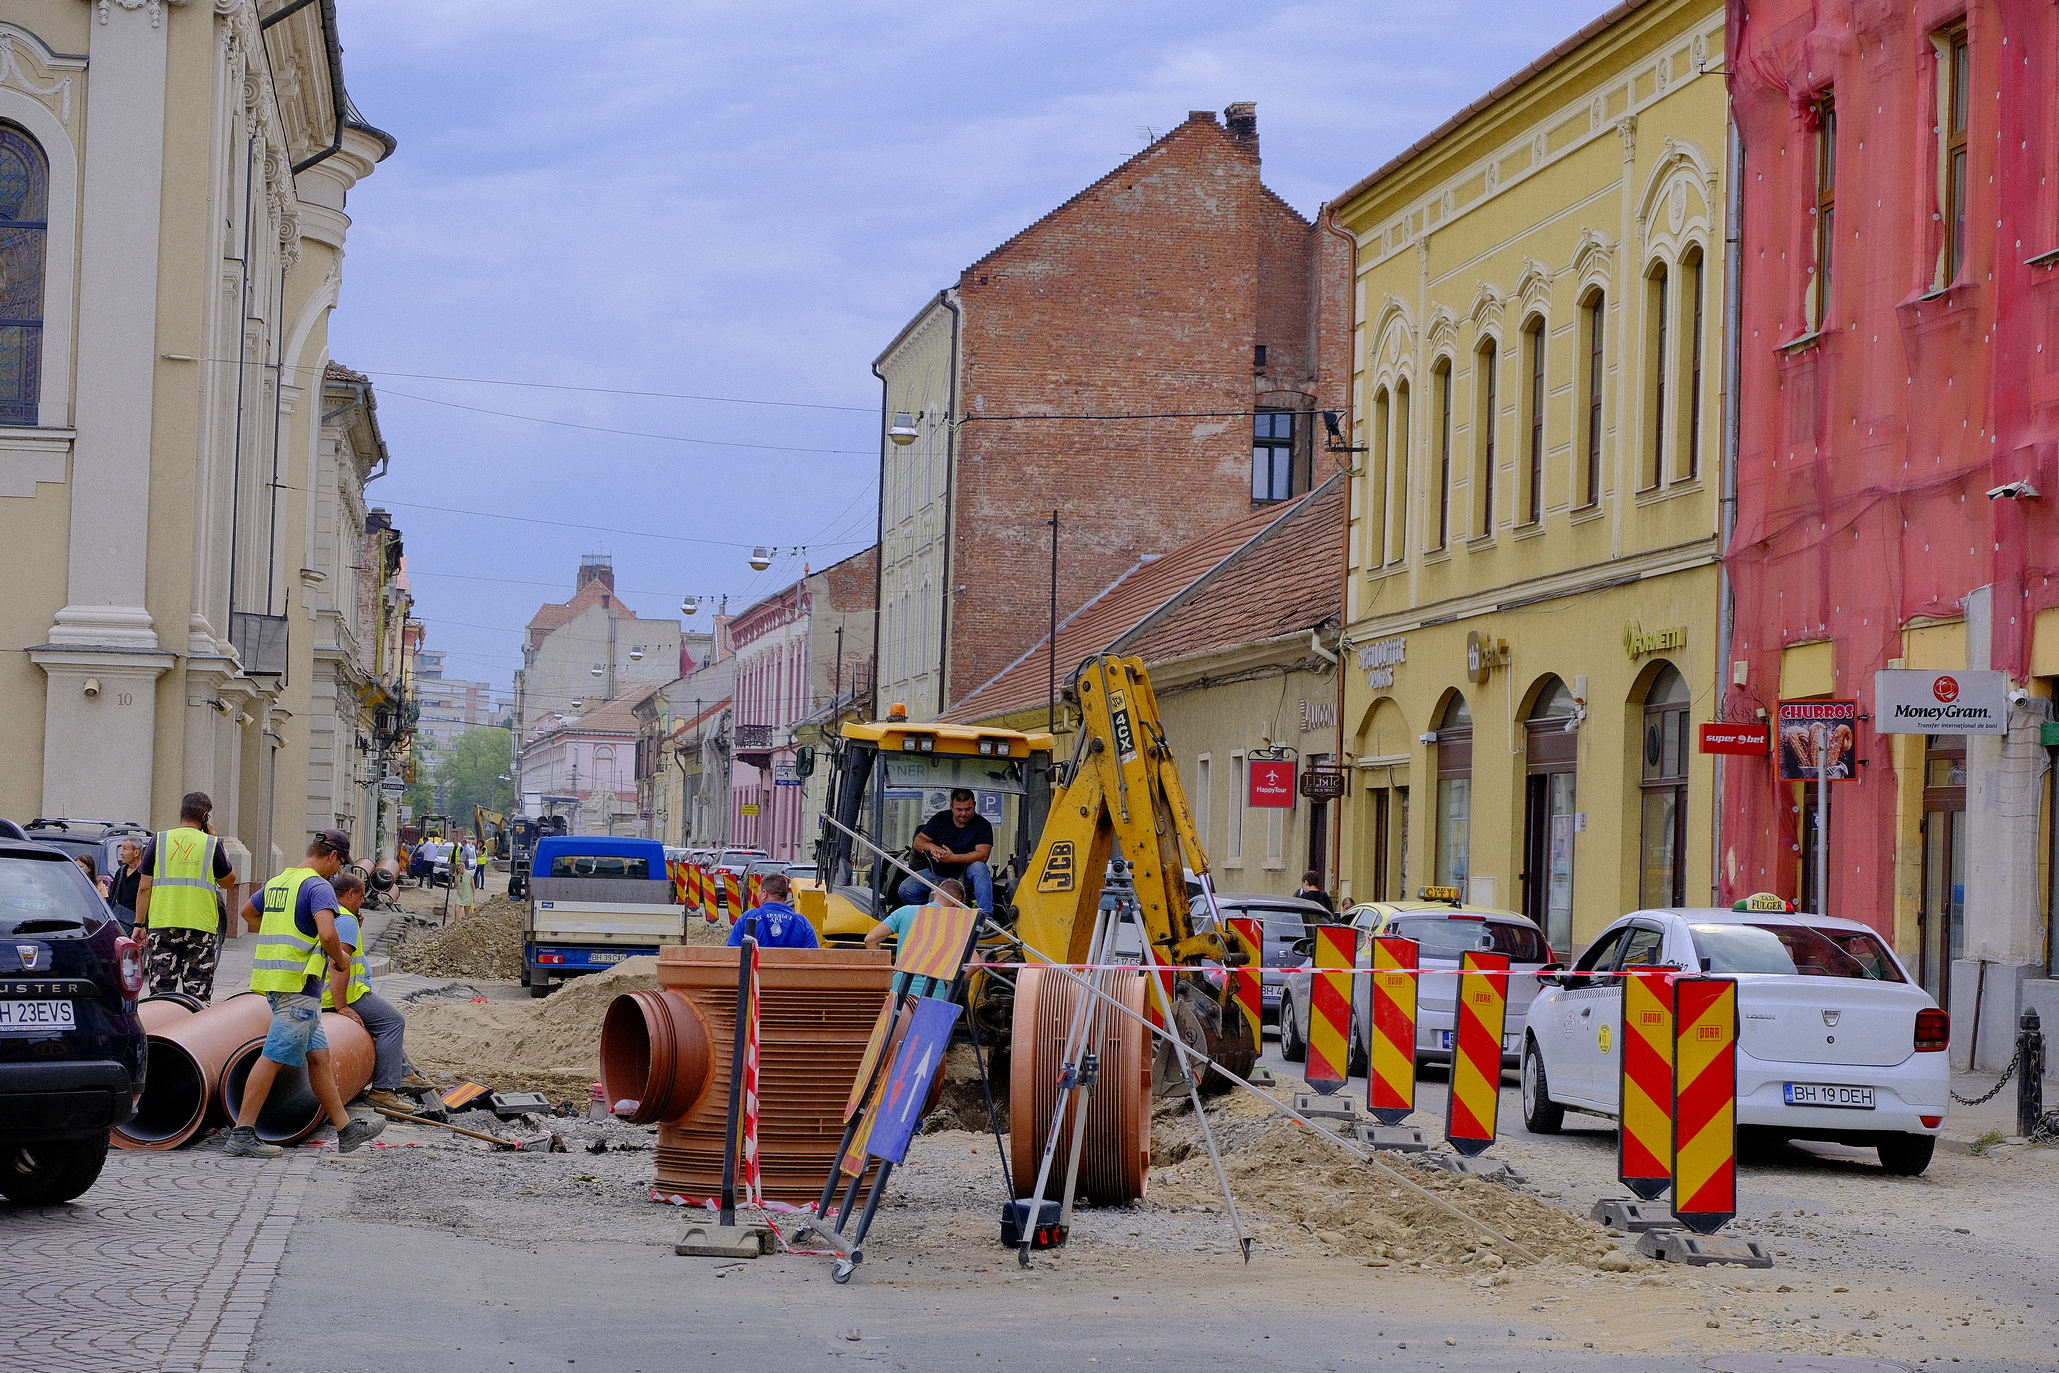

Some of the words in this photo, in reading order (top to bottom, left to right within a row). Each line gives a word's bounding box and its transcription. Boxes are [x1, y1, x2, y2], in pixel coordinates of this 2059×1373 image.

[1468, 643, 1480, 671] tbi
[117, 692, 133, 706] 10
[1112, 696, 1122, 708] JCB
[1779, 704, 1855, 720] CHURROS
[1894, 704, 1988, 721] MoneyGram
[1115, 713, 1133, 752] 4CX
[1917, 722, 1940, 730] Transfer
[985, 796, 996, 810] P
[1042, 843, 1073, 889] JCB
[1426, 888, 1453, 897] CITY
[1751, 899, 1783, 910] FULGER
[592, 953, 602, 961] BH
[1121, 957, 1129, 965] 17
[1793, 1086, 1817, 1101] BH
[1821, 1087, 1836, 1102] 19
[1839, 1089, 1873, 1104] DEH
